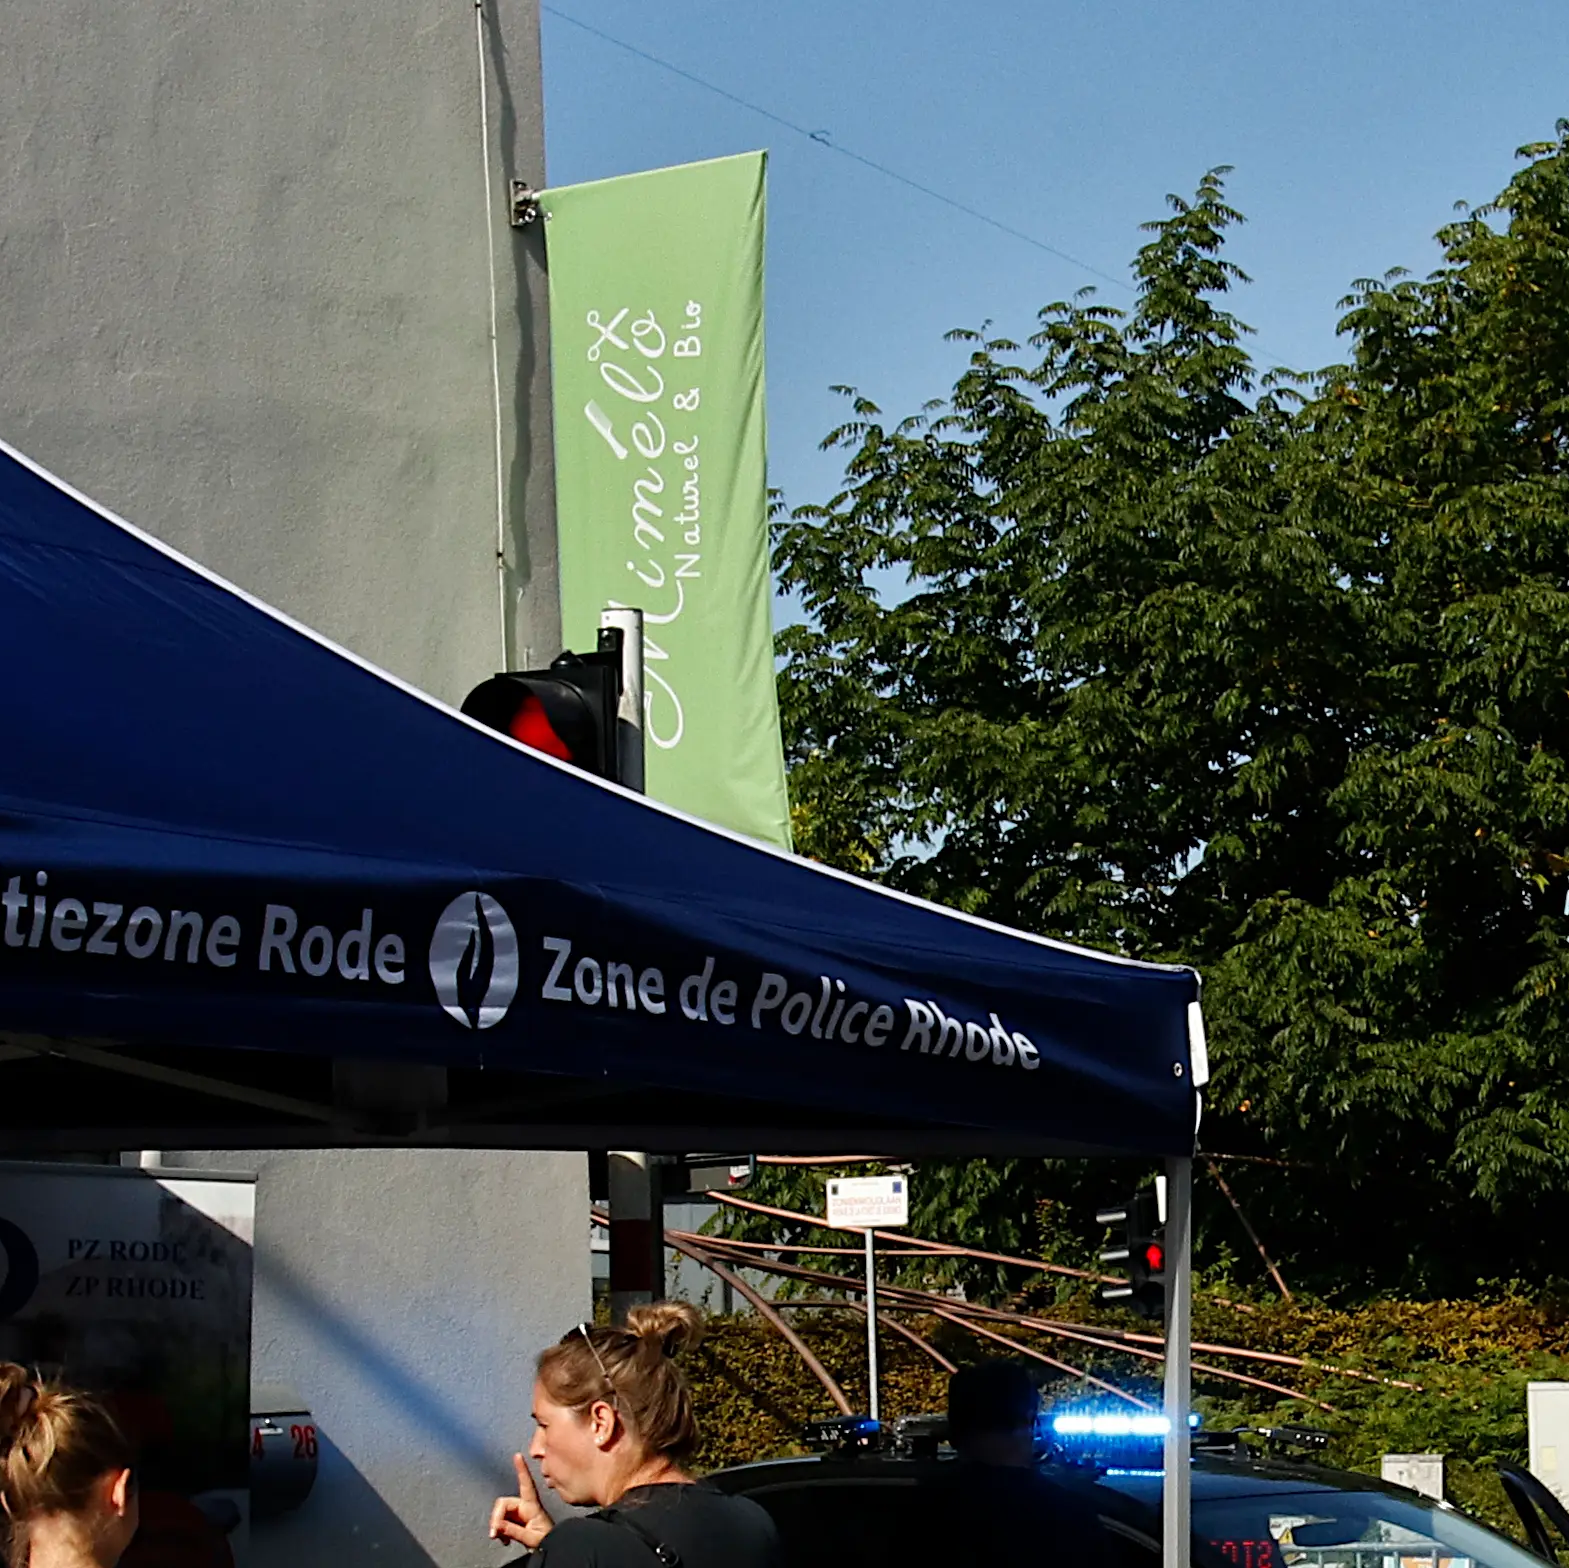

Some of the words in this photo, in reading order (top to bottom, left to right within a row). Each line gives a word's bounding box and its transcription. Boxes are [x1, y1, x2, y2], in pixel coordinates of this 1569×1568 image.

[673, 299, 703, 358] Bio
[673, 387, 701, 411] &
[673, 434, 702, 579] Naturel
[258, 903, 406, 986] Rode
[541, 935, 667, 1015] Zone
[680, 955, 739, 1026] de
[751, 971, 895, 1048] Police
[899, 997, 1042, 1070] Rhode
[67, 1238, 101, 1261] PZ
[109, 1239, 188, 1265] RODE
[64, 1276, 100, 1297] ZP
[106, 1277, 206, 1301] RHODE
[289, 1424, 318, 1461] 26
